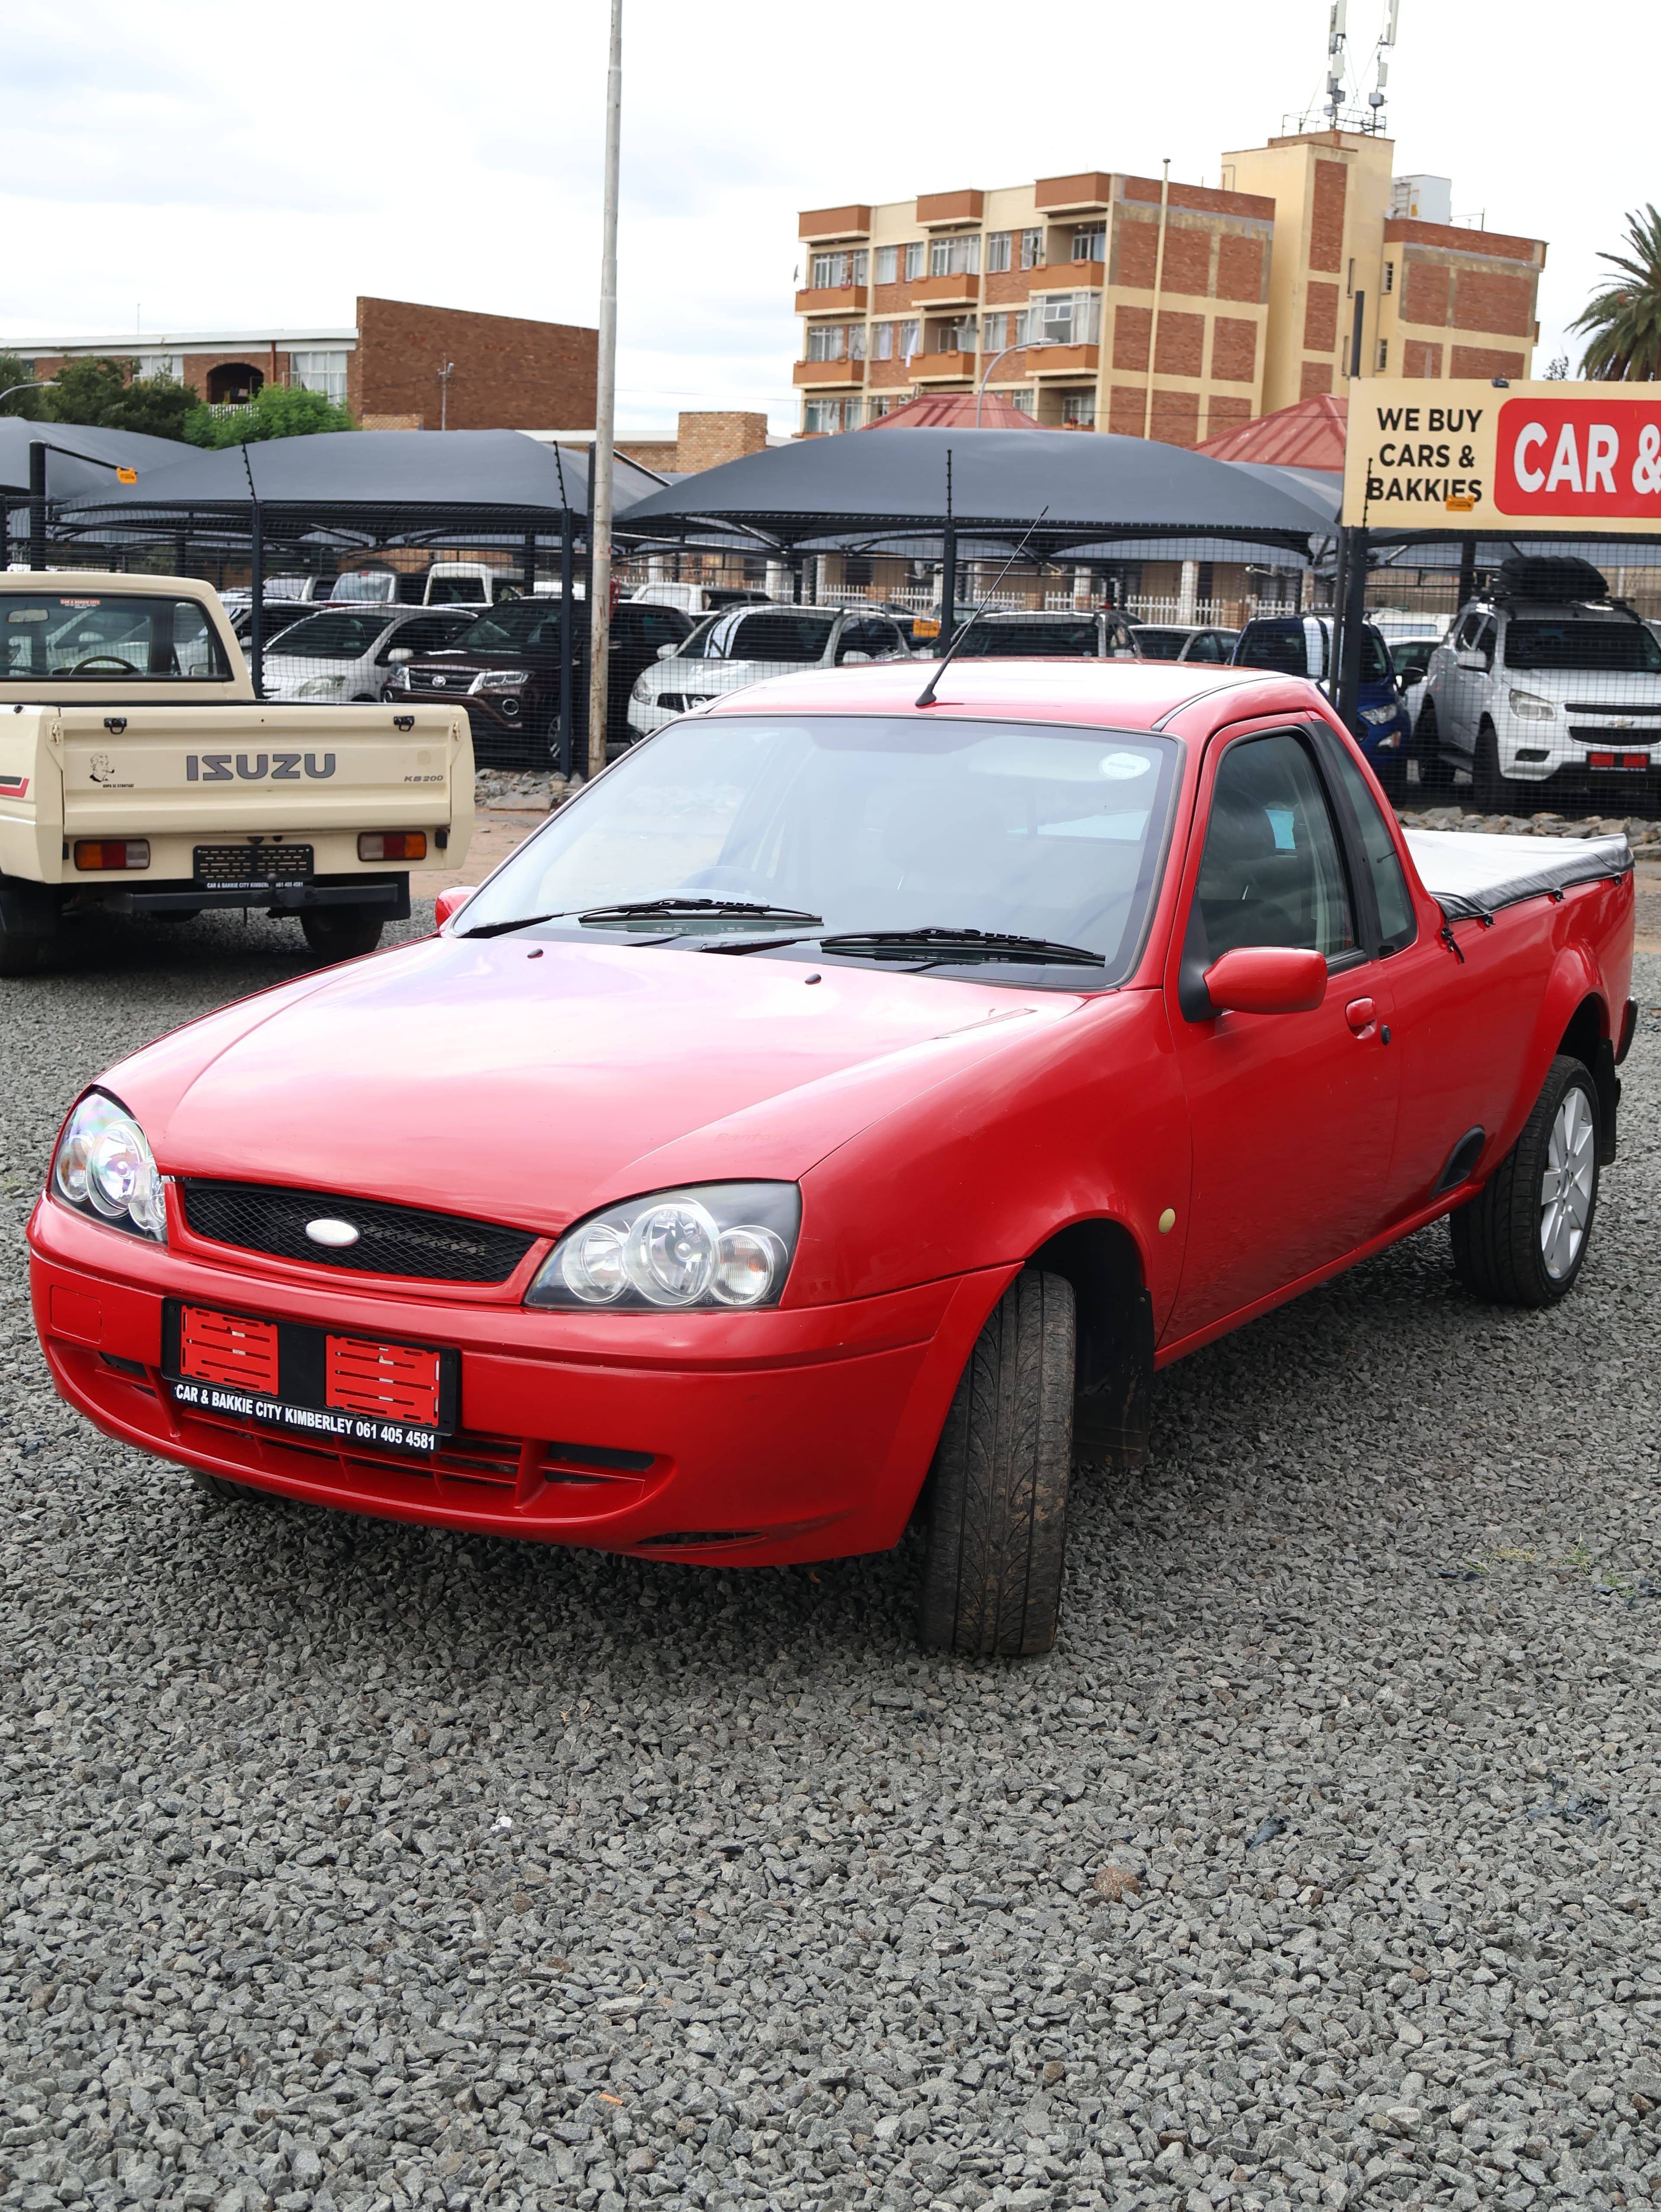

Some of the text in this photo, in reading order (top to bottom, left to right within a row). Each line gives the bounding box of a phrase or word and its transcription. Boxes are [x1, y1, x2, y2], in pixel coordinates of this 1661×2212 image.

[1377, 408, 1483, 432] WE BUY
[1380, 444, 1475, 468] CARS &
[1513, 422, 1661, 495] CAR &
[1367, 477, 1482, 503] BAKKIES
[186, 753, 336, 781] ISUZU
[176, 1384, 435, 1450] CAR & BAKKIE CITY KIMBERLEY 061 405 4581
